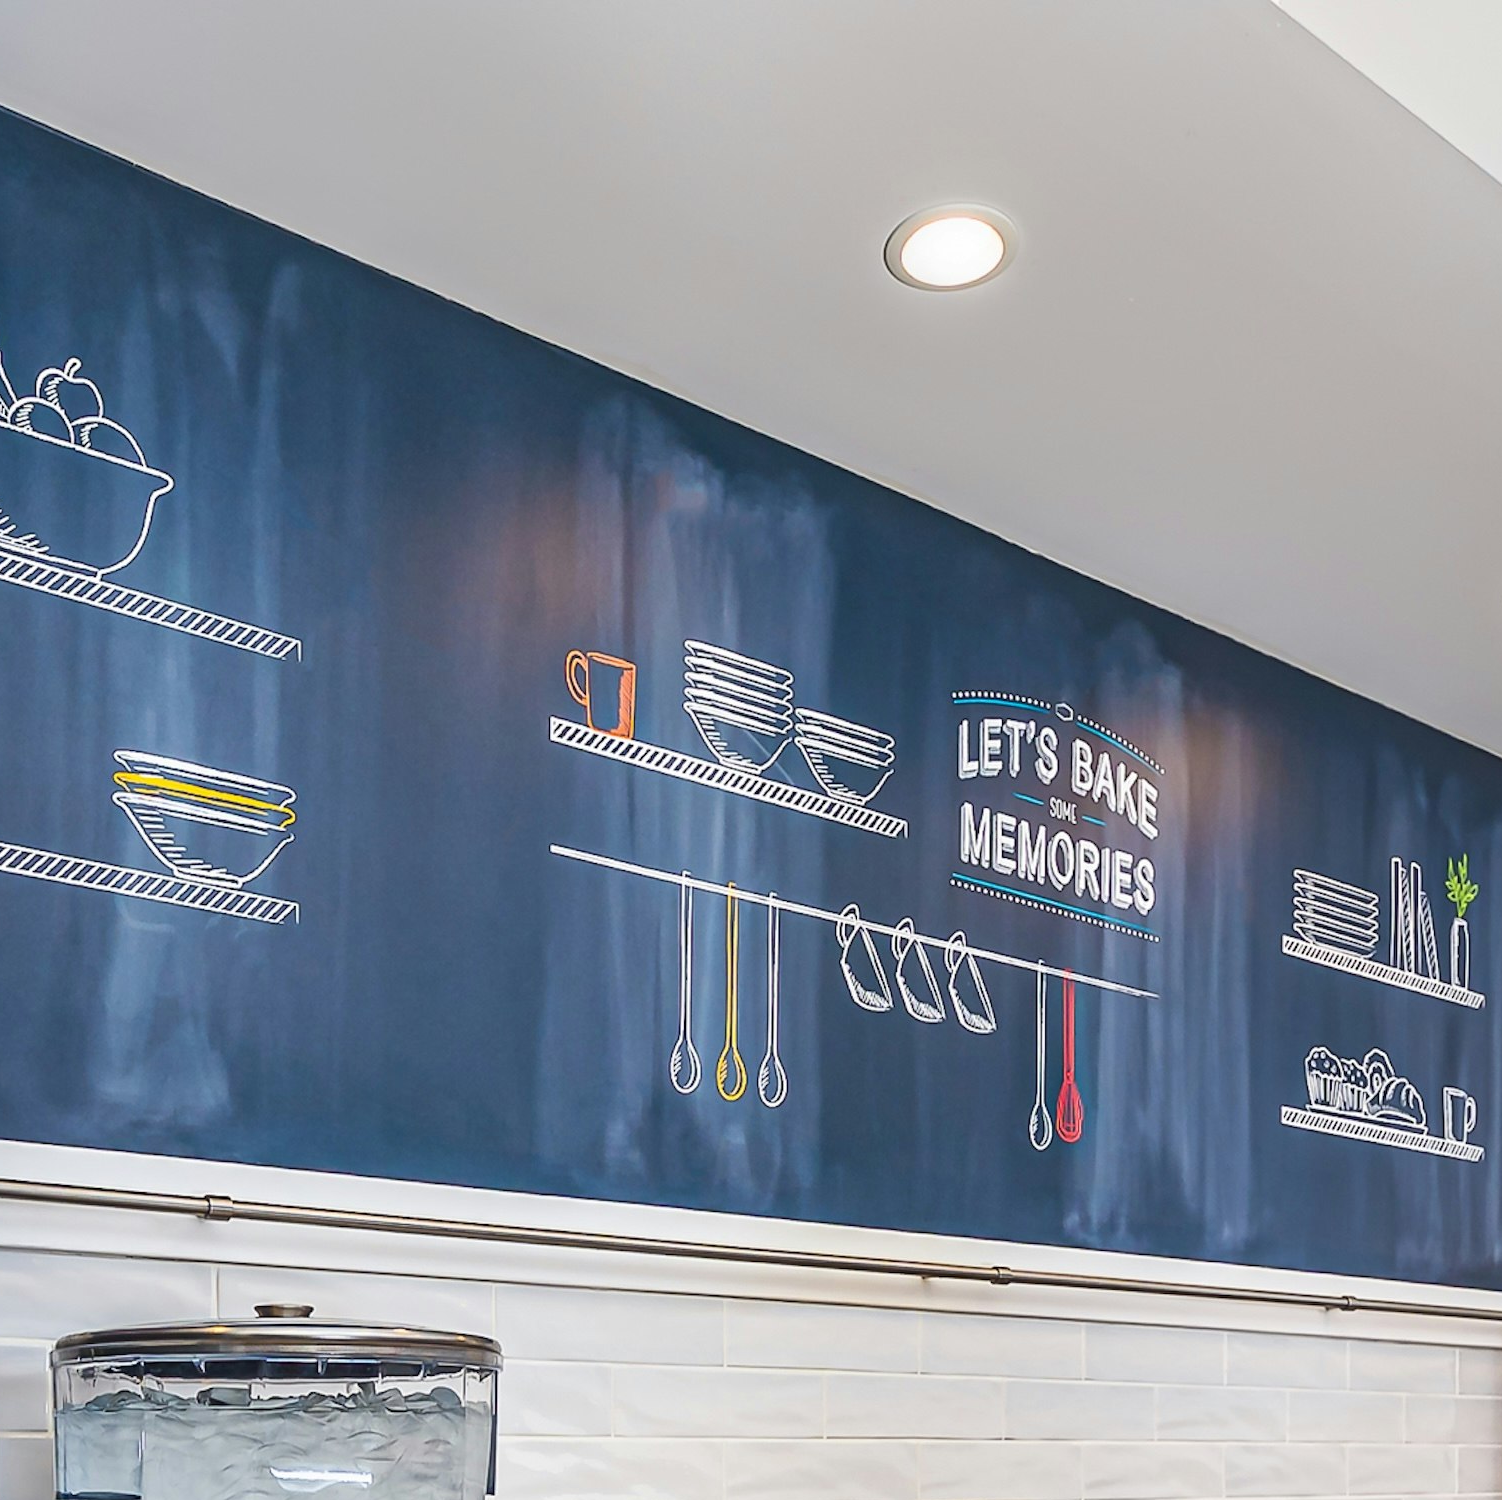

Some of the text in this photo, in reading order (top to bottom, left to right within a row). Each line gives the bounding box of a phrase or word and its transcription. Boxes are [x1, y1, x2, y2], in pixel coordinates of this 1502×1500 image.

[958, 718, 1160, 840] LET'S BAKE
[1049, 796, 1078, 825] SOME
[960, 801, 1157, 916] MEMORIES
